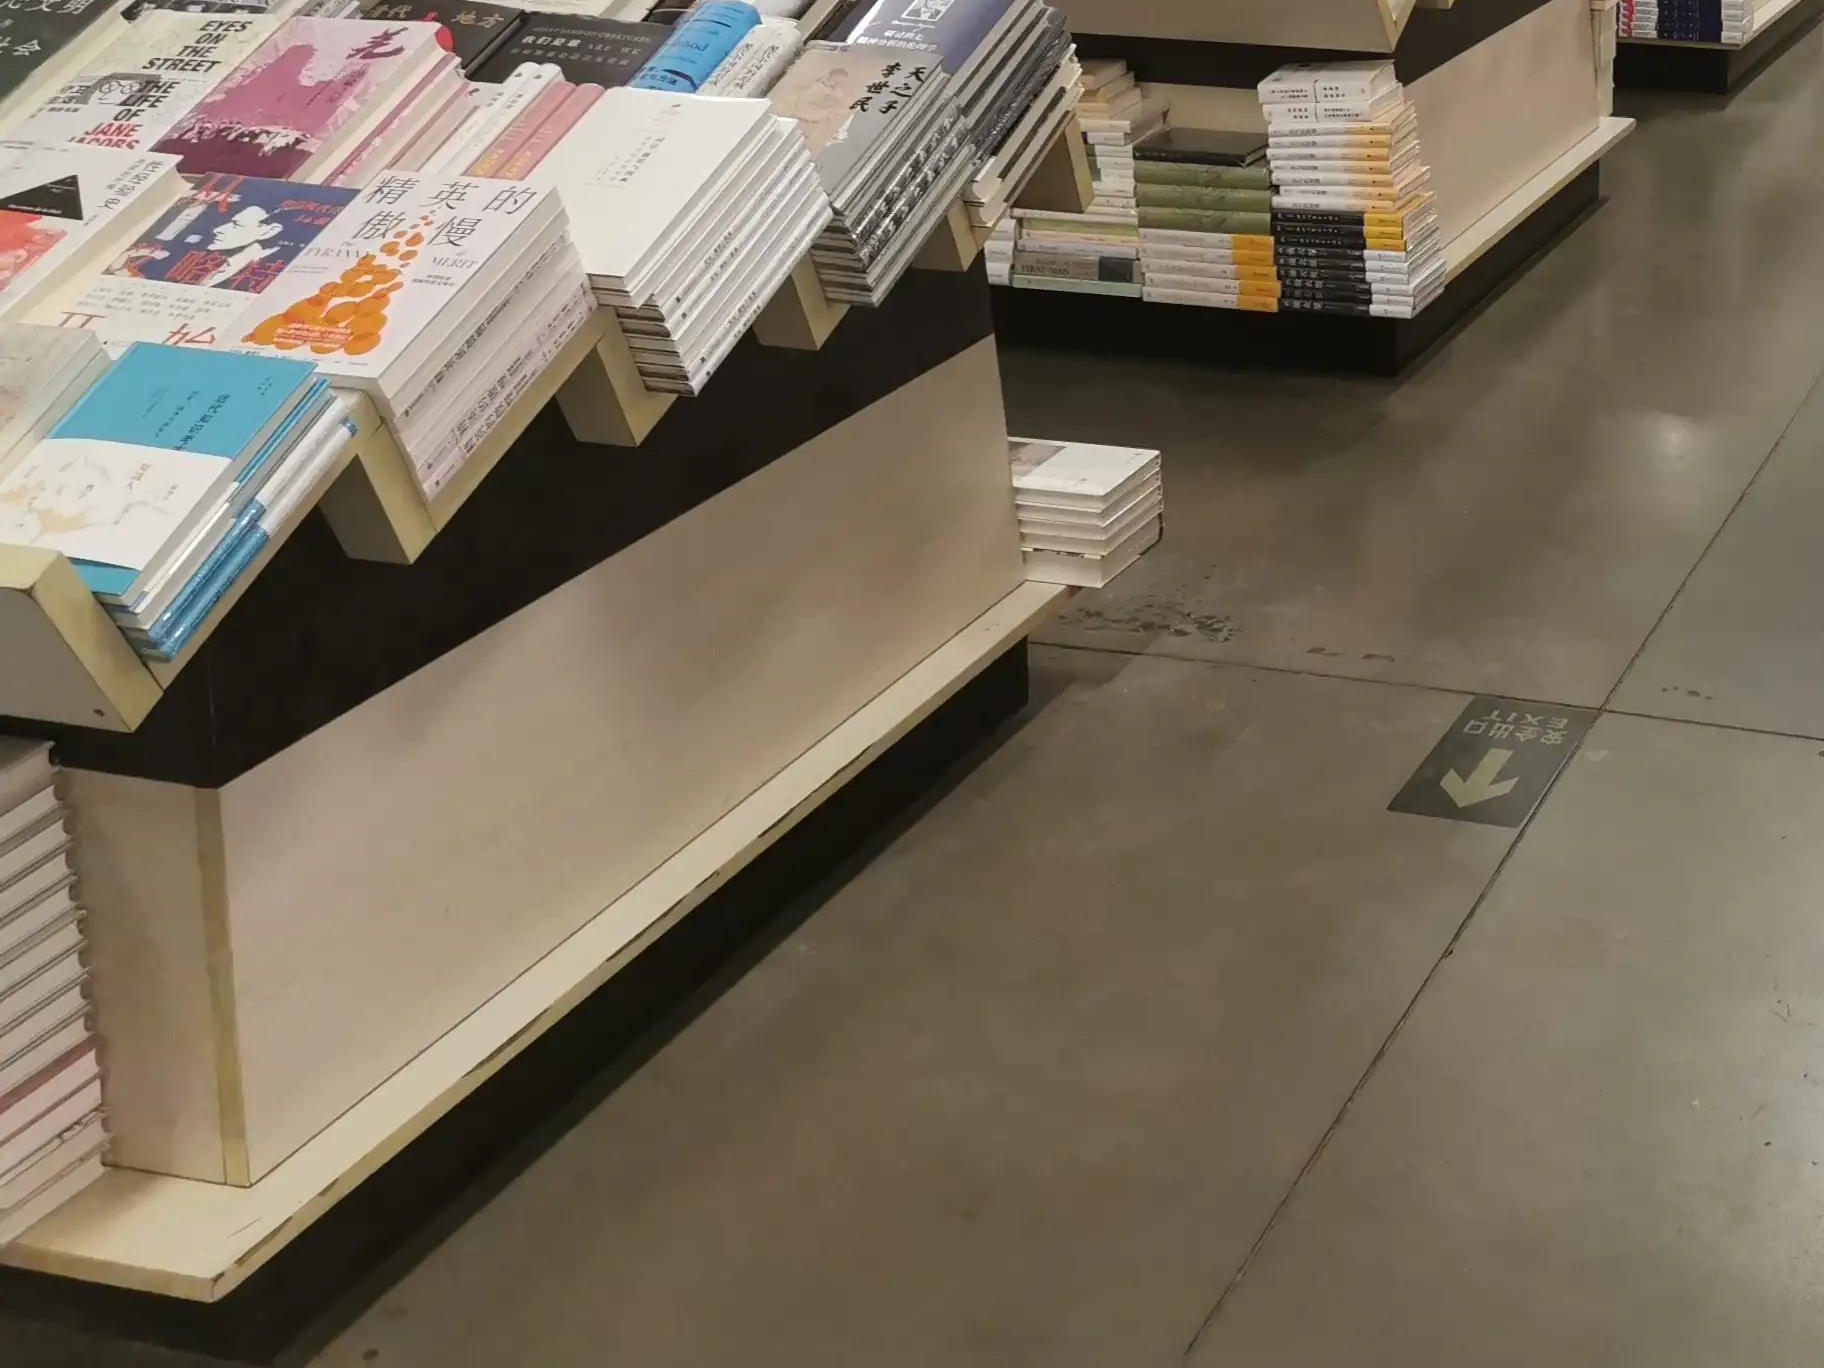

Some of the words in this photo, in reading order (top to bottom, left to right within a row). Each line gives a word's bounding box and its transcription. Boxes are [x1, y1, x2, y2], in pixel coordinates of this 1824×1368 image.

[199, 20, 253, 32] EYES
[195, 33, 225, 44] ON
[176, 45, 217, 58] THE
[142, 58, 221, 73] STREET
[139, 80, 181, 93] THE
[849, 62, 901, 113] 李世民
[878, 66, 927, 114] 天之子
[119, 94, 169, 108] LIFE
[113, 108, 146, 122] OF
[84, 122, 144, 138] JANE
[364, 175, 537, 216] 精英的
[352, 210, 483, 247] 傲慢
[431, 256, 480, 270] MERIT
[1482, 710, 1569, 730] EXIT
[1463, 719, 1569, 745] 安全出口
